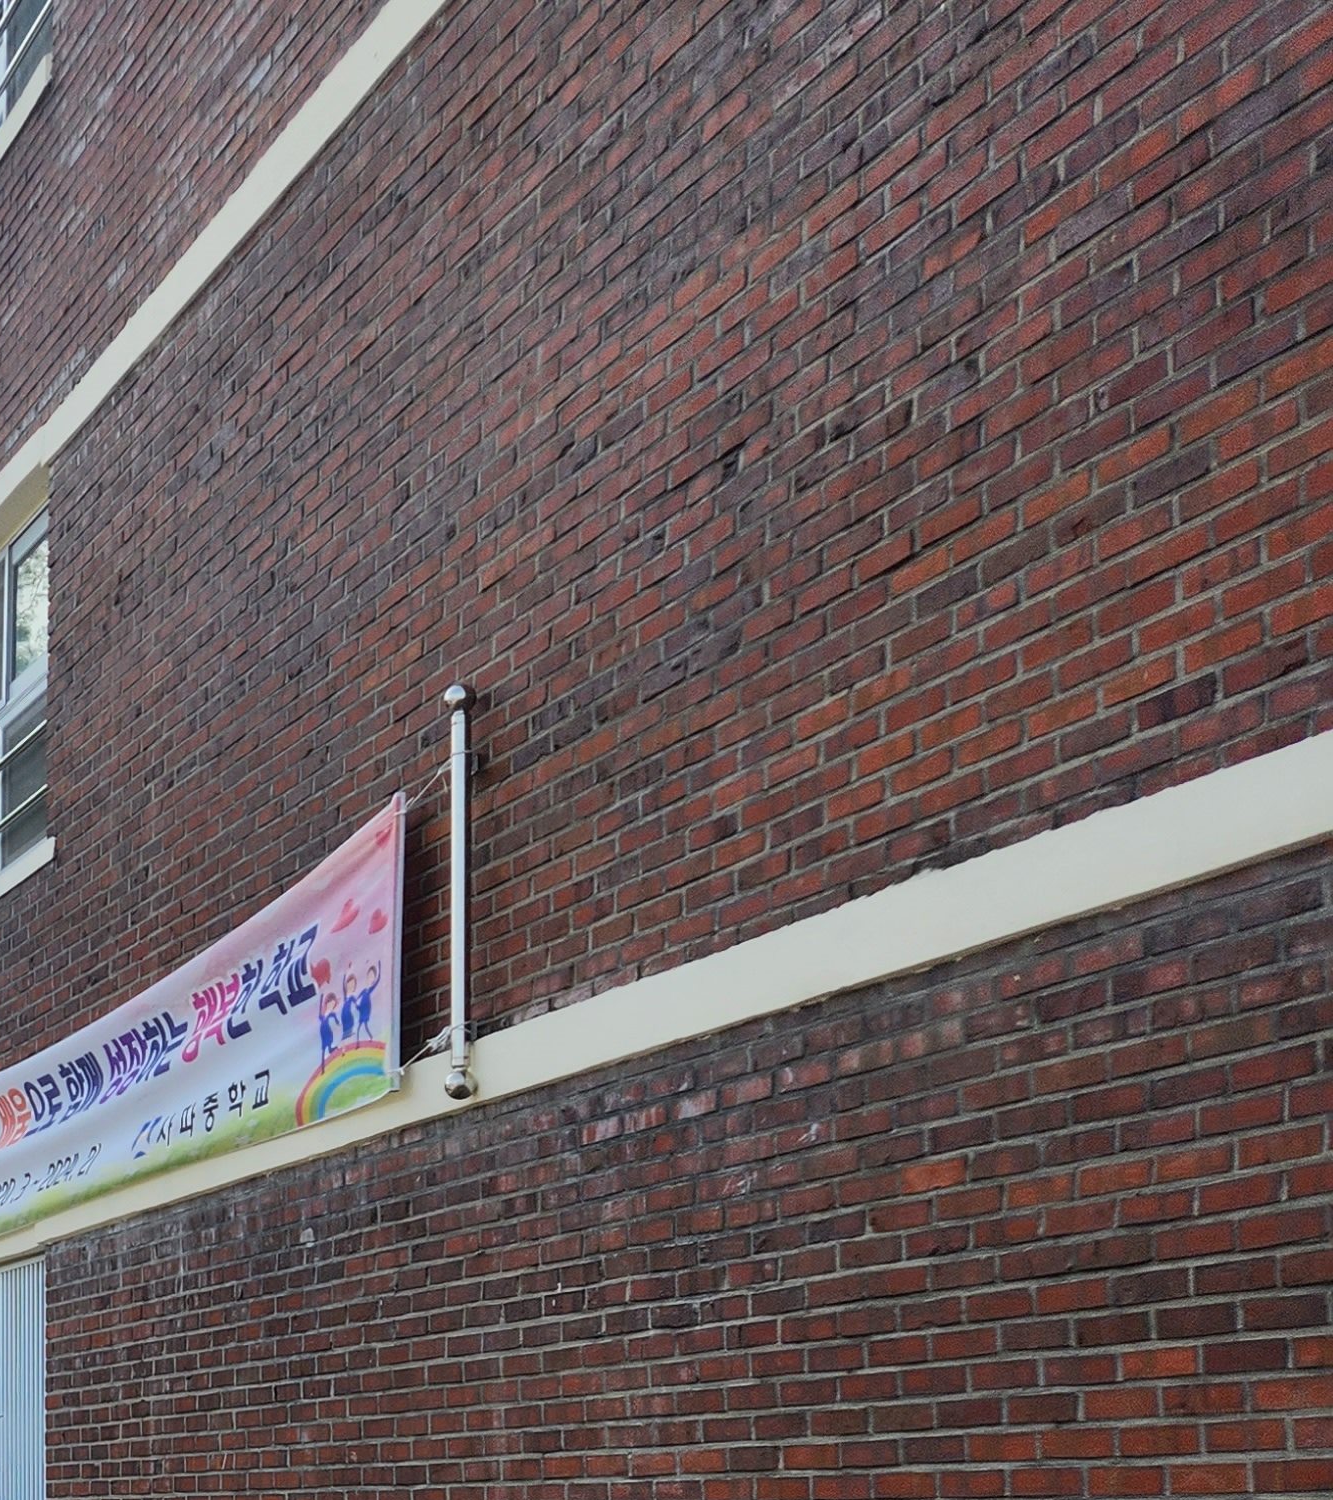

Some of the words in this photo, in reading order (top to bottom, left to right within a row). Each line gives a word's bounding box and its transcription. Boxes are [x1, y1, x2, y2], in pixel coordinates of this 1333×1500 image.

[58, 1051, 104, 1124] 함께
[99, 1011, 189, 1104] 성장하는
[182, 959, 264, 1063] 행복한
[259, 922, 320, 1016] 학교
